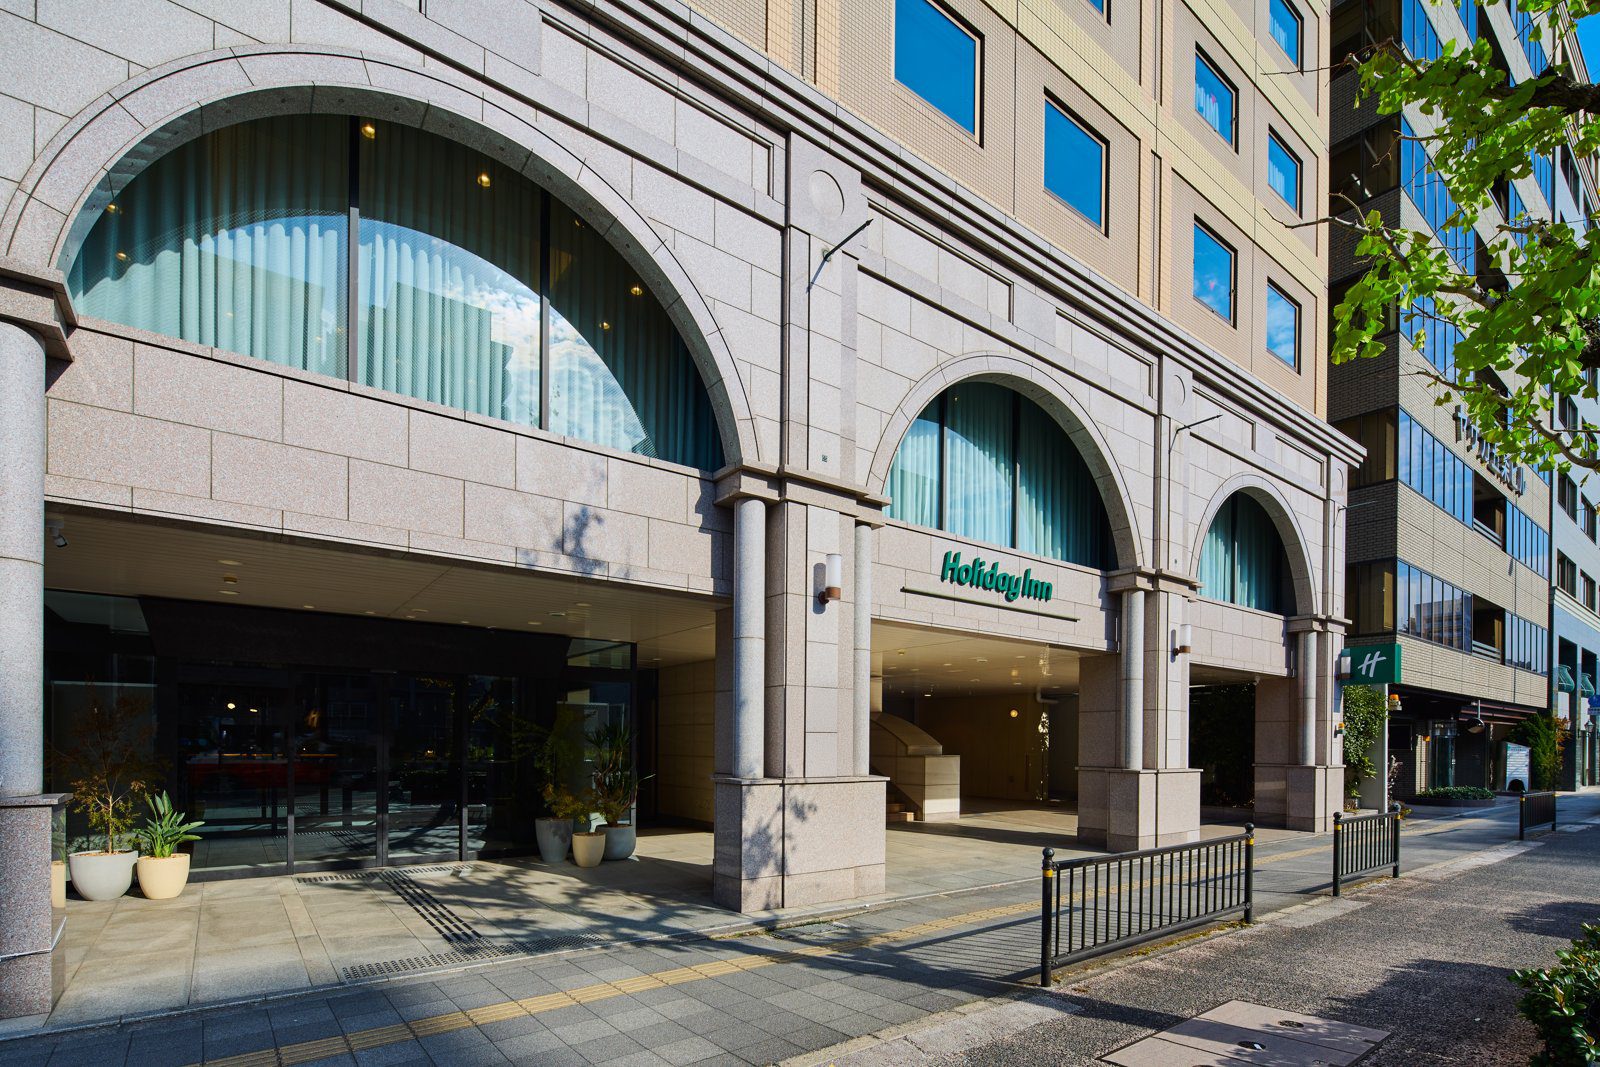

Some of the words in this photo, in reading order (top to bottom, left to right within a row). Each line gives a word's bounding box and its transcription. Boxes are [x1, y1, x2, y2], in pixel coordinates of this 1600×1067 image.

[941, 551, 1022, 602] Holiday
[1021, 568, 1053, 602] Inn
[1358, 651, 1387, 677] H
